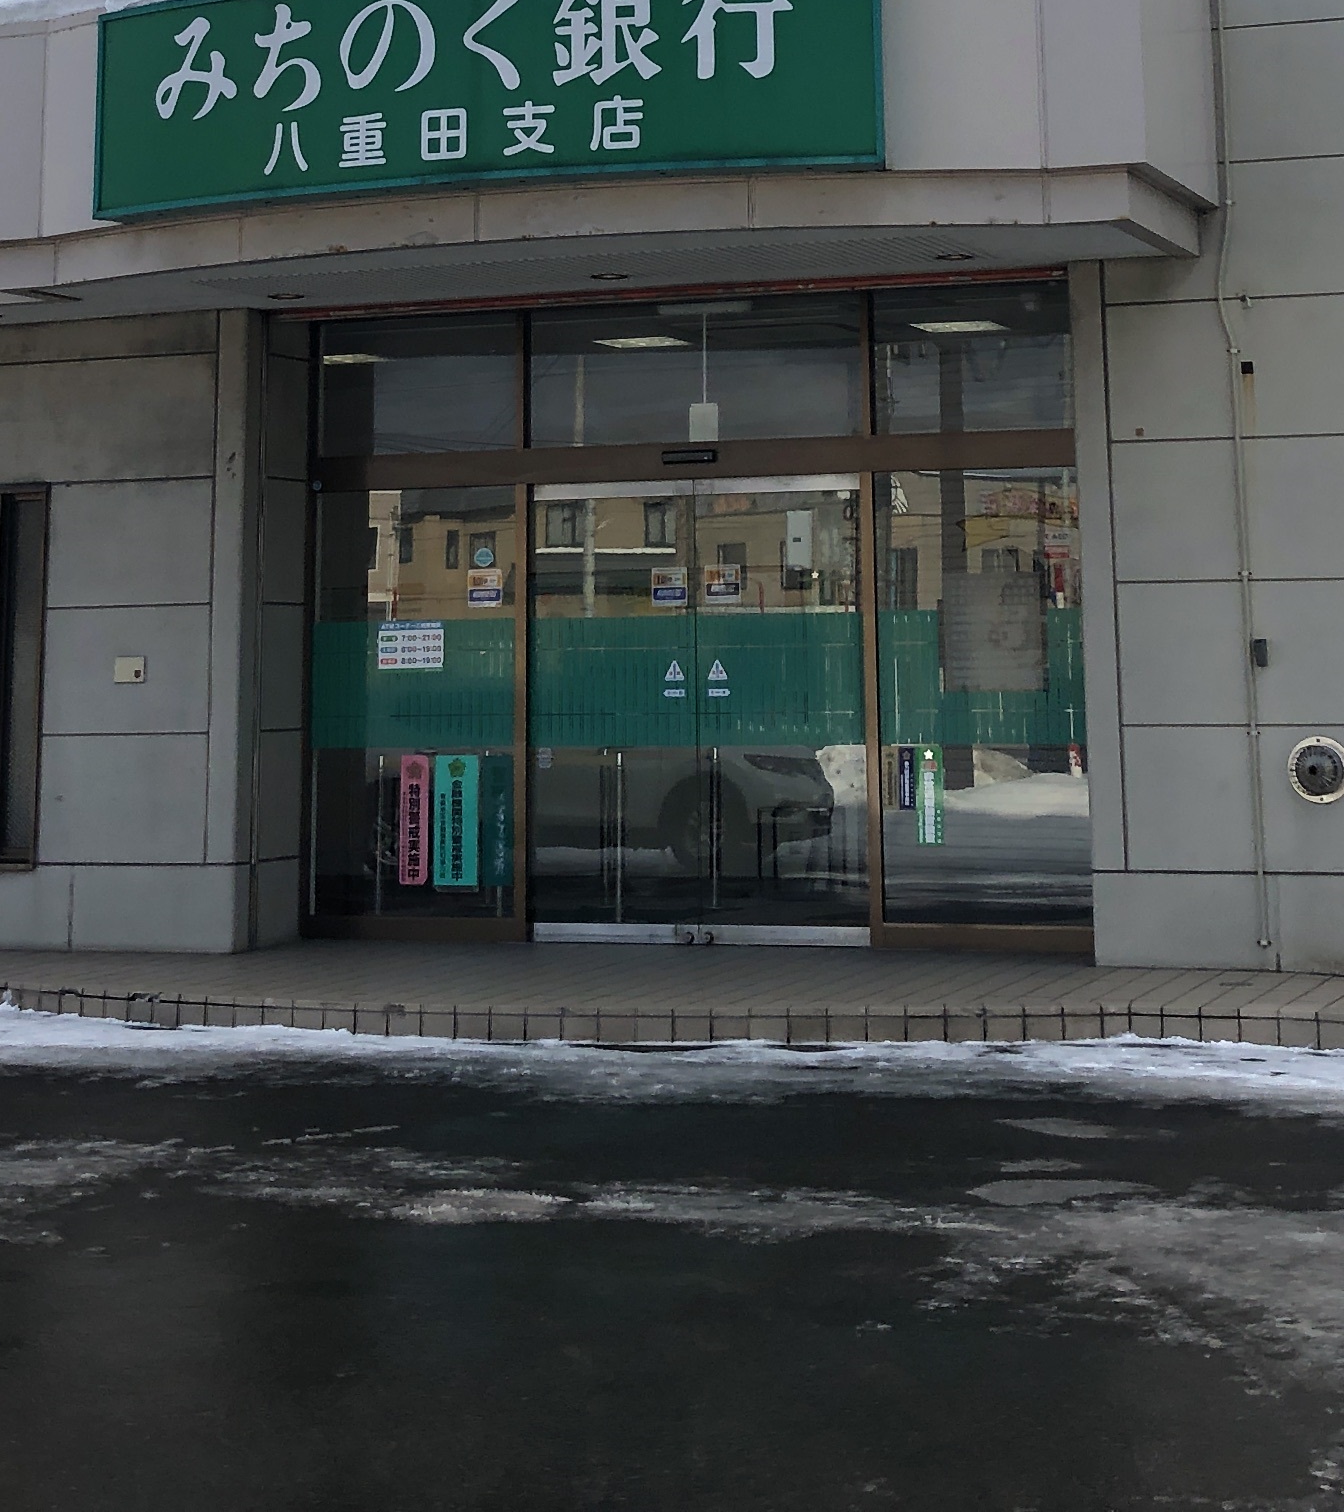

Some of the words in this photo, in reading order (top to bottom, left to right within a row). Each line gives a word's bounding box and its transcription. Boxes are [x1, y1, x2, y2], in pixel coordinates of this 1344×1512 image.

[264, 94, 644, 176] 八重田支店
[407, 783, 420, 881] 特別警戒実施中
